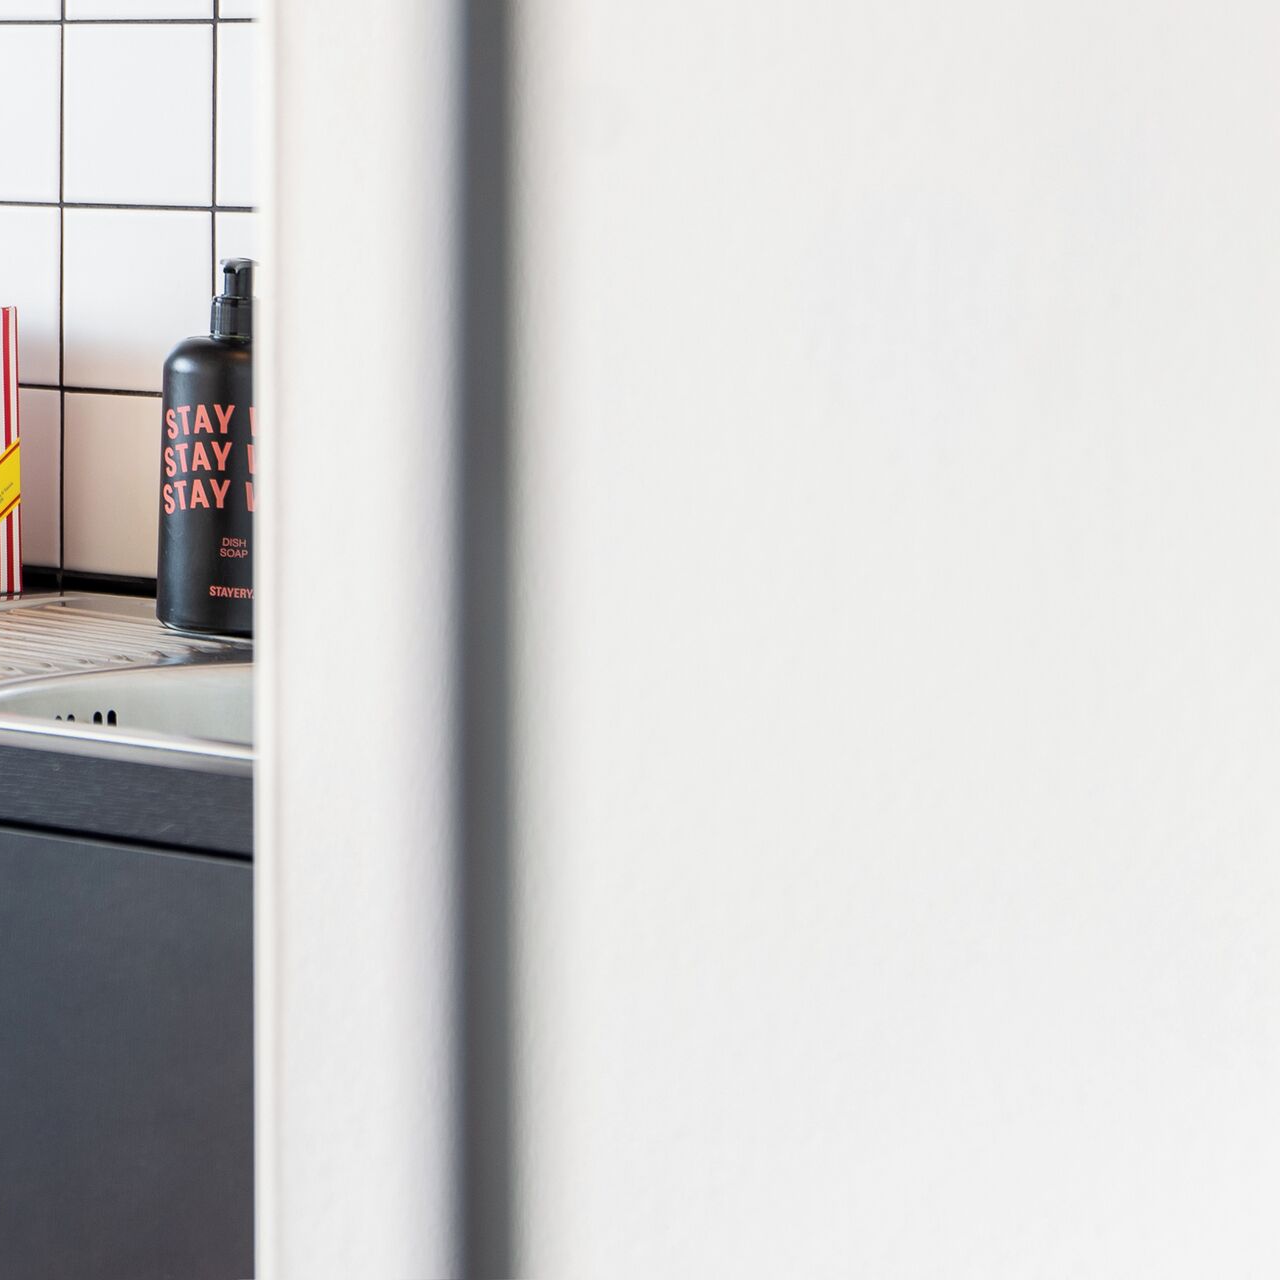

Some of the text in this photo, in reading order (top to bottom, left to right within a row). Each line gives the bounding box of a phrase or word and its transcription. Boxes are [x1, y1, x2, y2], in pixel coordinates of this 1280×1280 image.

[166, 404, 236, 439] STAY
[164, 441, 233, 477] STAY
[163, 478, 231, 514] STAY
[220, 548, 248, 558] SOAP
[222, 537, 247, 548] DISH
